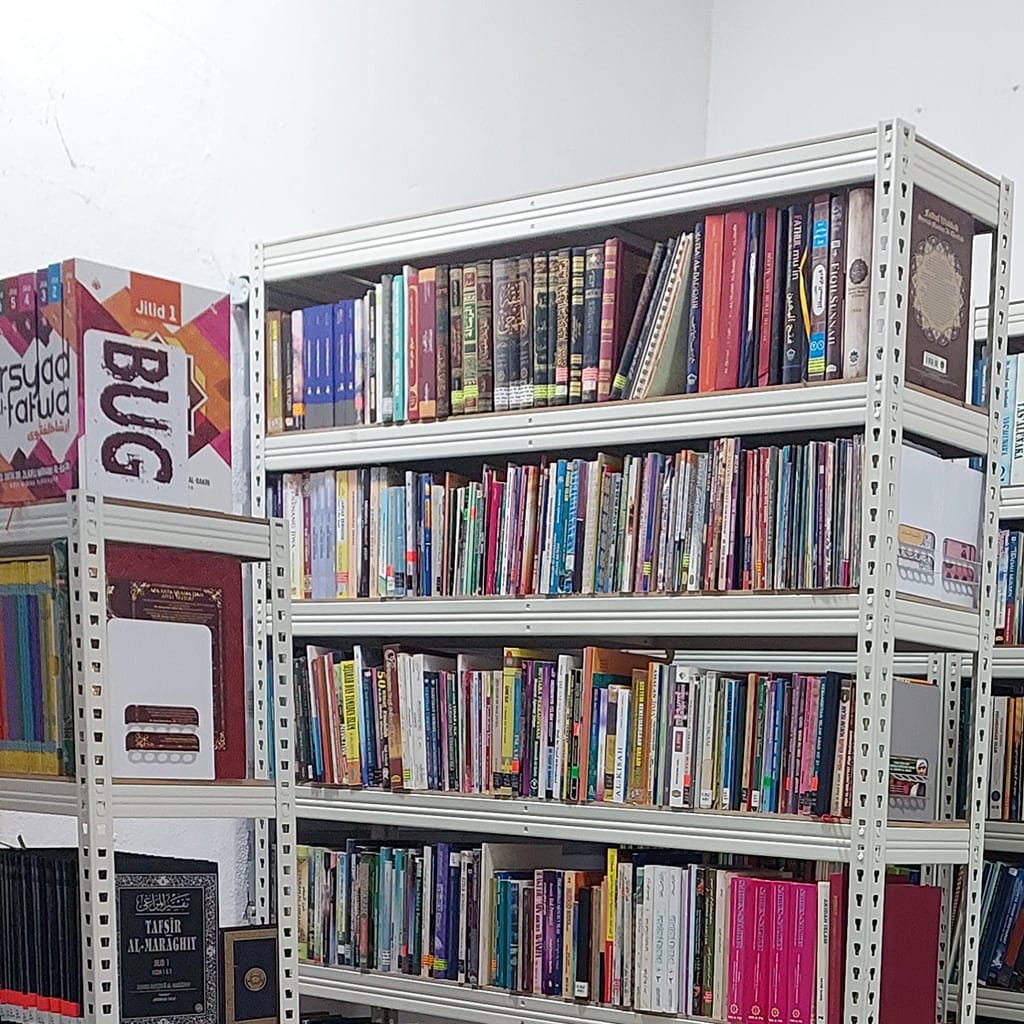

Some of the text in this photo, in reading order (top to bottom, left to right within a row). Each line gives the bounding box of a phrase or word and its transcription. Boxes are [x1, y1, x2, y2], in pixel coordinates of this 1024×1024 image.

[135, 299, 177, 322] Jilid 1
[99, 339, 174, 485] BUG
